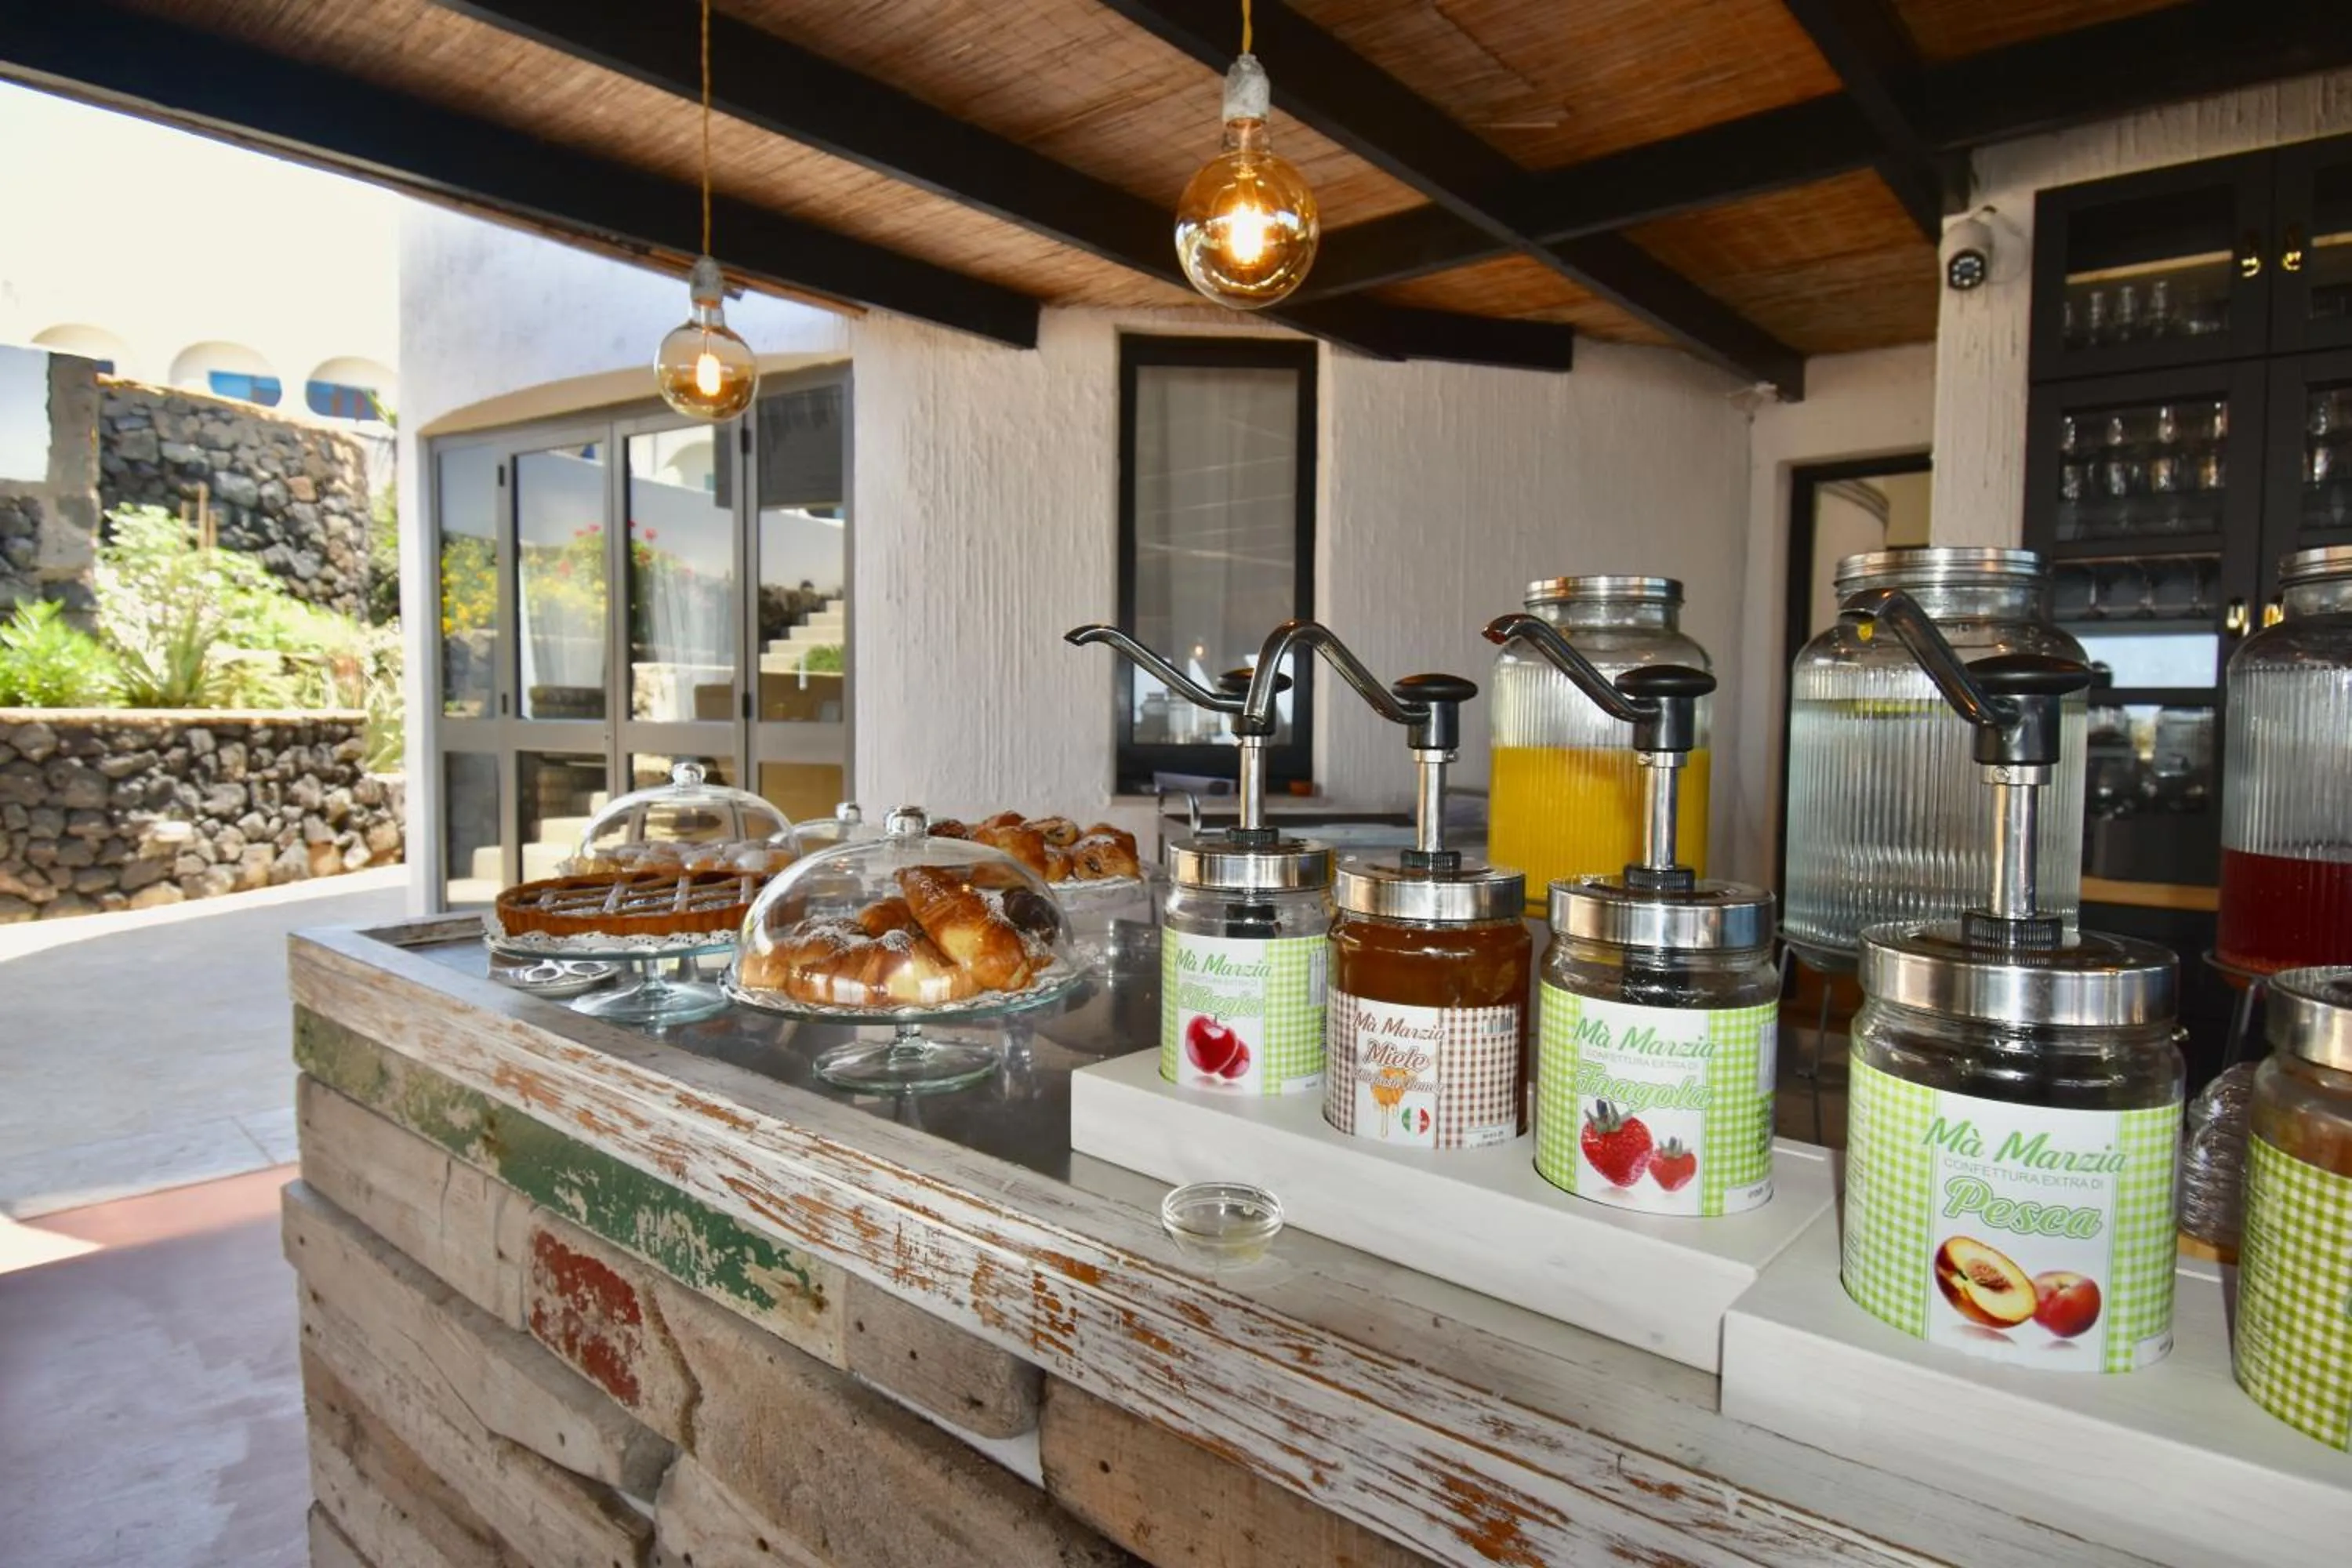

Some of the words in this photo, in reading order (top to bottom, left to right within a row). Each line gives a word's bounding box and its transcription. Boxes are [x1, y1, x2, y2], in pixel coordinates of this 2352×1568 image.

[1174, 949, 1197, 971] Mà
[1201, 953, 1271, 978] Marzia
[1353, 1011, 1377, 1032] Mà
[1381, 1017, 1446, 1040] Marzia
[1573, 1017, 1612, 1049] Mà
[1618, 1025, 1717, 1058] Marzia
[1362, 1037, 1431, 1073] Miele
[1575, 1059, 1715, 1112] Fragola
[1923, 1116, 1984, 1158] Mà
[1993, 1130, 2128, 1173] Marzia
[1944, 1156, 2040, 1184] CONFETTURA
[2042, 1175, 2090, 1189] EXTRA
[2091, 1178, 2104, 1190] DI
[1943, 1175, 2103, 1240] Pesca
